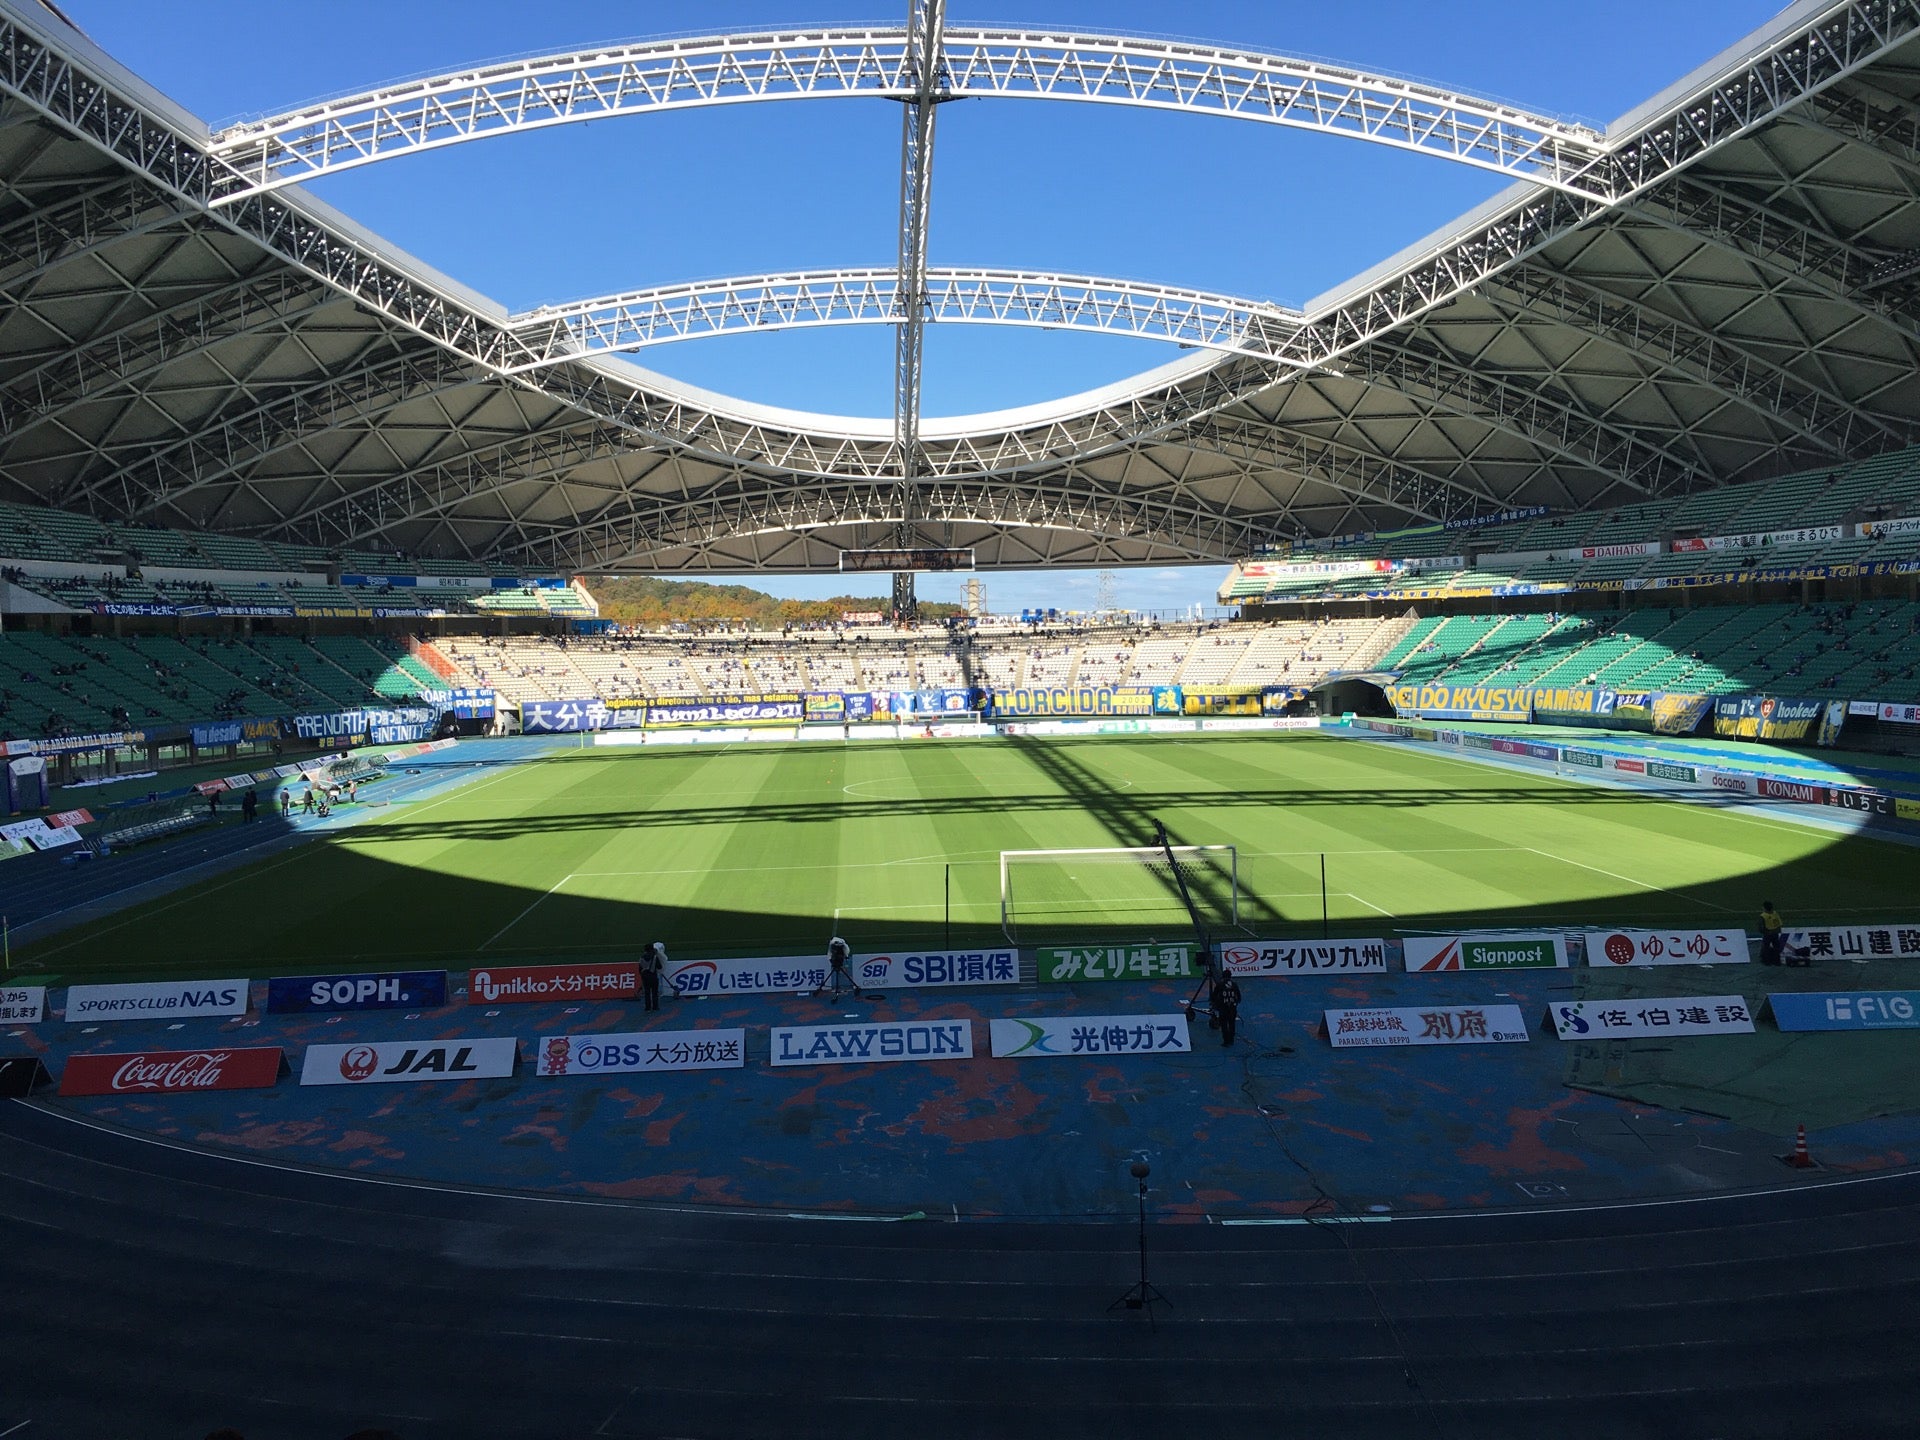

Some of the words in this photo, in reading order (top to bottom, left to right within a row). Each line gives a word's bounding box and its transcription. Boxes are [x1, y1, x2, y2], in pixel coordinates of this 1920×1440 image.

[1797, 527, 1838, 542] まるひで
[1597, 545, 1647, 557] DAIHATSU
[456, 698, 493, 708] PRIDE
[743, 695, 761, 703] mas
[995, 687, 1113, 715] TORCIDA
[1122, 696, 1146, 704] 2002
[1451, 687, 1530, 711] KYUSYU
[1595, 690, 1615, 714] 12
[1720, 703, 1737, 715] am
[1712, 775, 1746, 790] docomo
[1766, 781, 1813, 801] KONAMI
[1843, 793, 1887, 814] いちご
[1641, 934, 1732, 961] ゆこゆこ
[1807, 929, 1920, 956] 栗山建設
[1052, 948, 1191, 979] みどり牛乳
[1260, 944, 1384, 970] ダイハツ九州
[1472, 946, 1543, 965] Signpost
[549, 972, 636, 992] 大分中央店
[674, 973, 712, 992] SBI
[719, 968, 825, 989] いきいき少短
[862, 964, 888, 978] SBI
[179, 989, 237, 1008] NAS
[310, 978, 409, 1005] SOPH.
[1598, 1005, 1749, 1028] 佐伯建設
[1856, 996, 1914, 1020] FIG
[1336, 1016, 1408, 1035] 極楽地獄
[1418, 1009, 1488, 1040] 別府
[779, 1025, 964, 1060] LAWSON
[1072, 1023, 1183, 1052] 光伸ガス
[1338, 1037, 1370, 1046] PARADISE
[1389, 1036, 1410, 1044] BEPPU
[383, 1047, 477, 1075] JAL
[578, 1046, 640, 1069] OBS
[645, 1039, 739, 1065] 大分放送
[111, 1052, 232, 1091] Coca-Cola
[347, 1069, 369, 1078] JAL
